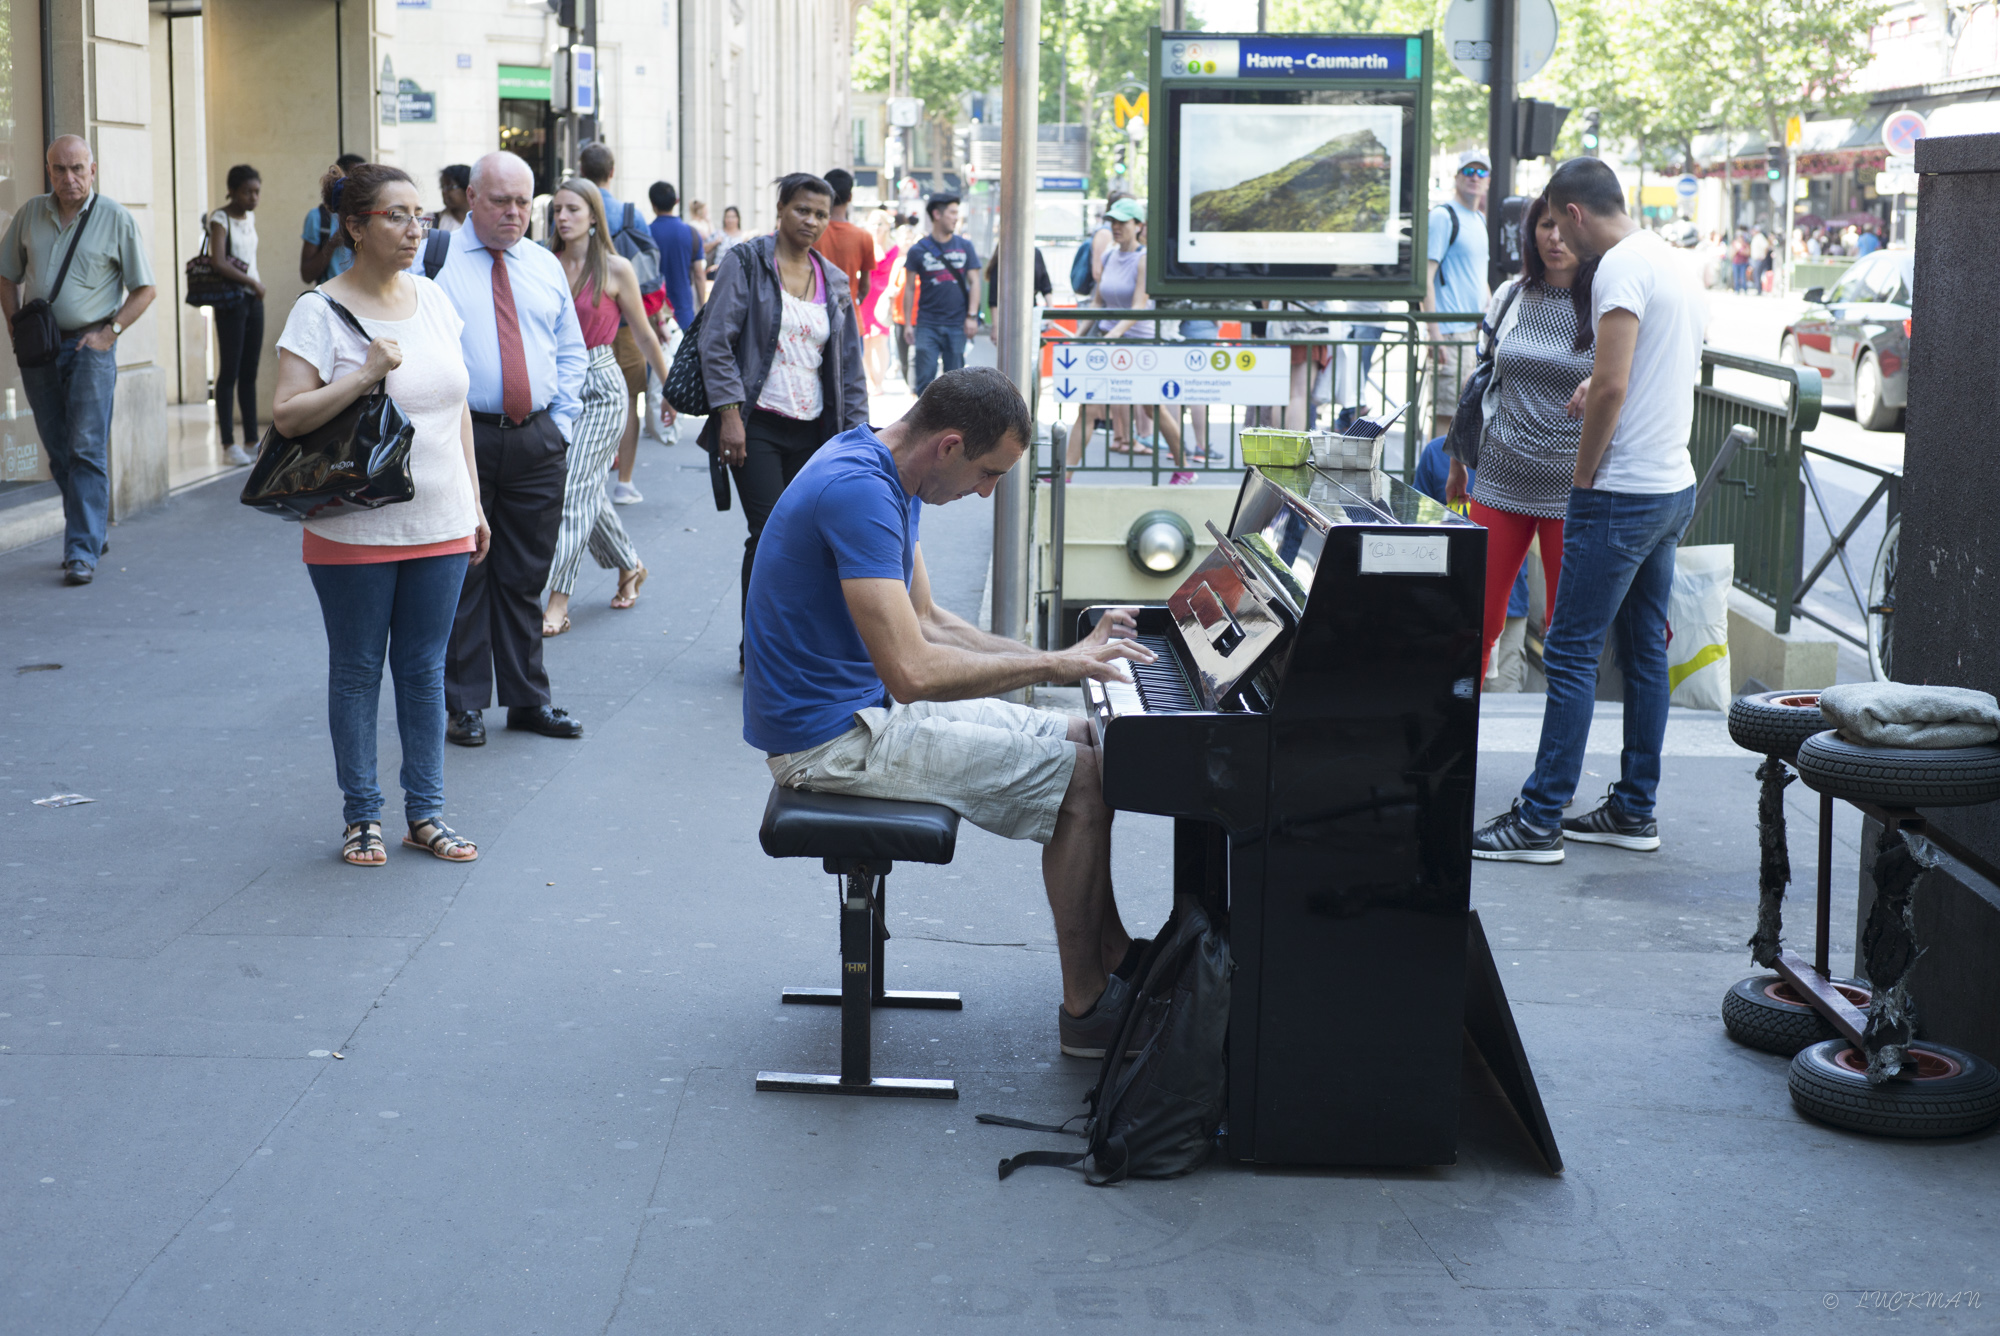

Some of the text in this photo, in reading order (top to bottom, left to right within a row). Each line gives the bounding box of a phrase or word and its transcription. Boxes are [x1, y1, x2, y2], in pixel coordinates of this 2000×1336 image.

[1114, 91, 1149, 128] M
[1089, 353, 1251, 369] RER A E M 3 9
